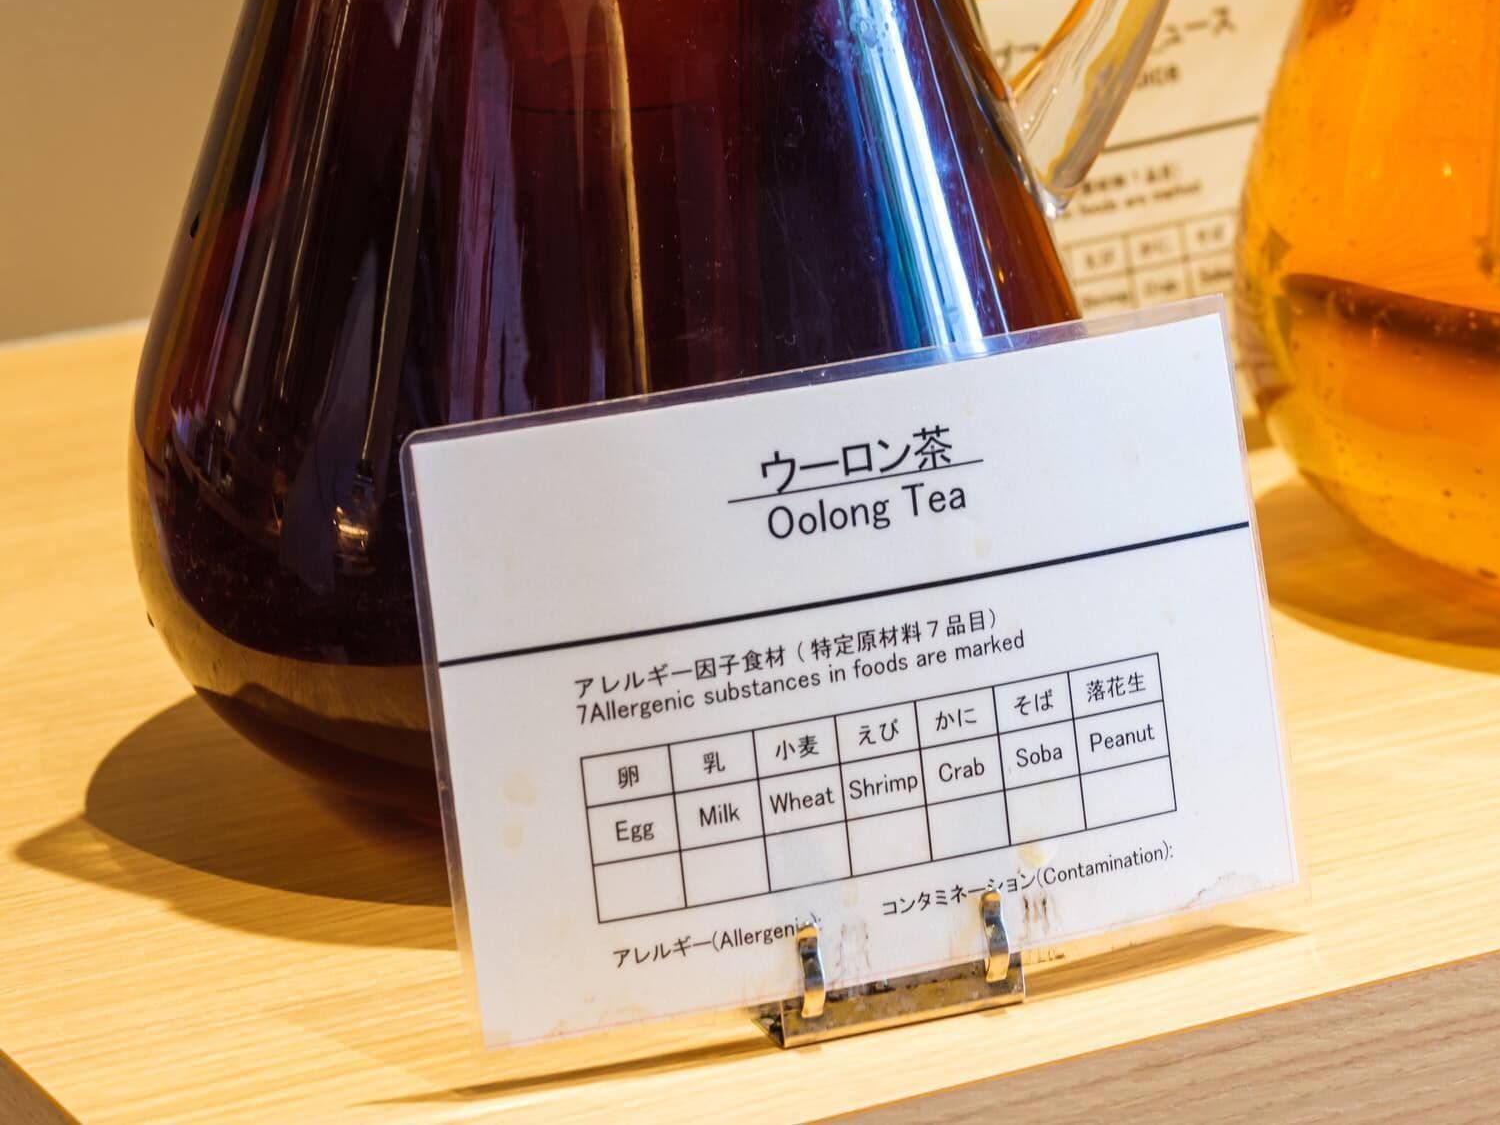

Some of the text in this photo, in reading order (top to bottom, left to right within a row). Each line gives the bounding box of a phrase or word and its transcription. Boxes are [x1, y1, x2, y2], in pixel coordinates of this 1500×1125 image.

[761, 425, 953, 494] ウーロン茶
[768, 483, 967, 539] Oolong Tea
[576, 630, 1025, 725] 7Allergenic substances in foods are marked
[617, 671, 1146, 789] 卵 乳 小麦 えび かに そば 落花生
[616, 723, 1156, 843] Egg Milk Wheat Shrimp Crab Soba Peanut
